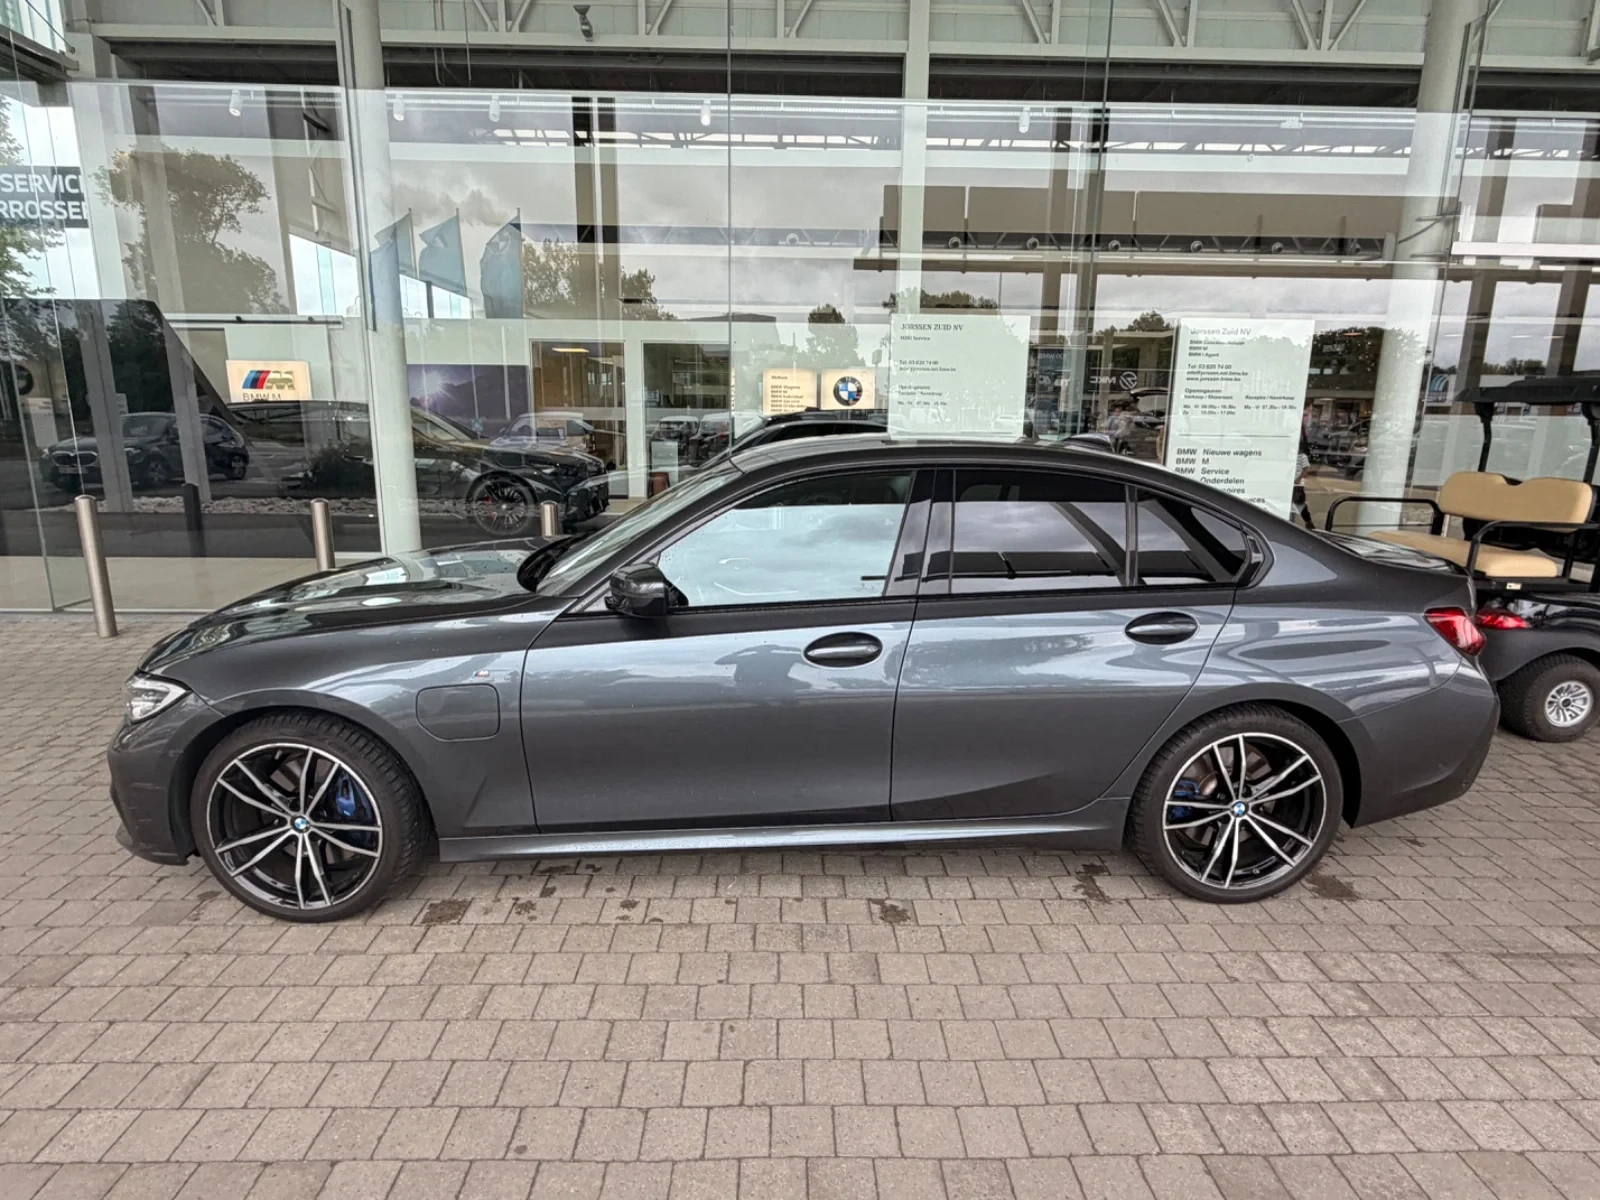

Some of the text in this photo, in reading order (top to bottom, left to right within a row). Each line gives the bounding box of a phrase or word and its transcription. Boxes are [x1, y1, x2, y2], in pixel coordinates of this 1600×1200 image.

[953, 323, 964, 331] NV
[1221, 328, 1238, 336] Zuid
[1239, 328, 1252, 336] NV
[1176, 448, 1263, 458] BMW Nieuwe wagens
[1200, 466, 1230, 475] Service
[1200, 476, 1245, 485] Onderdelen
